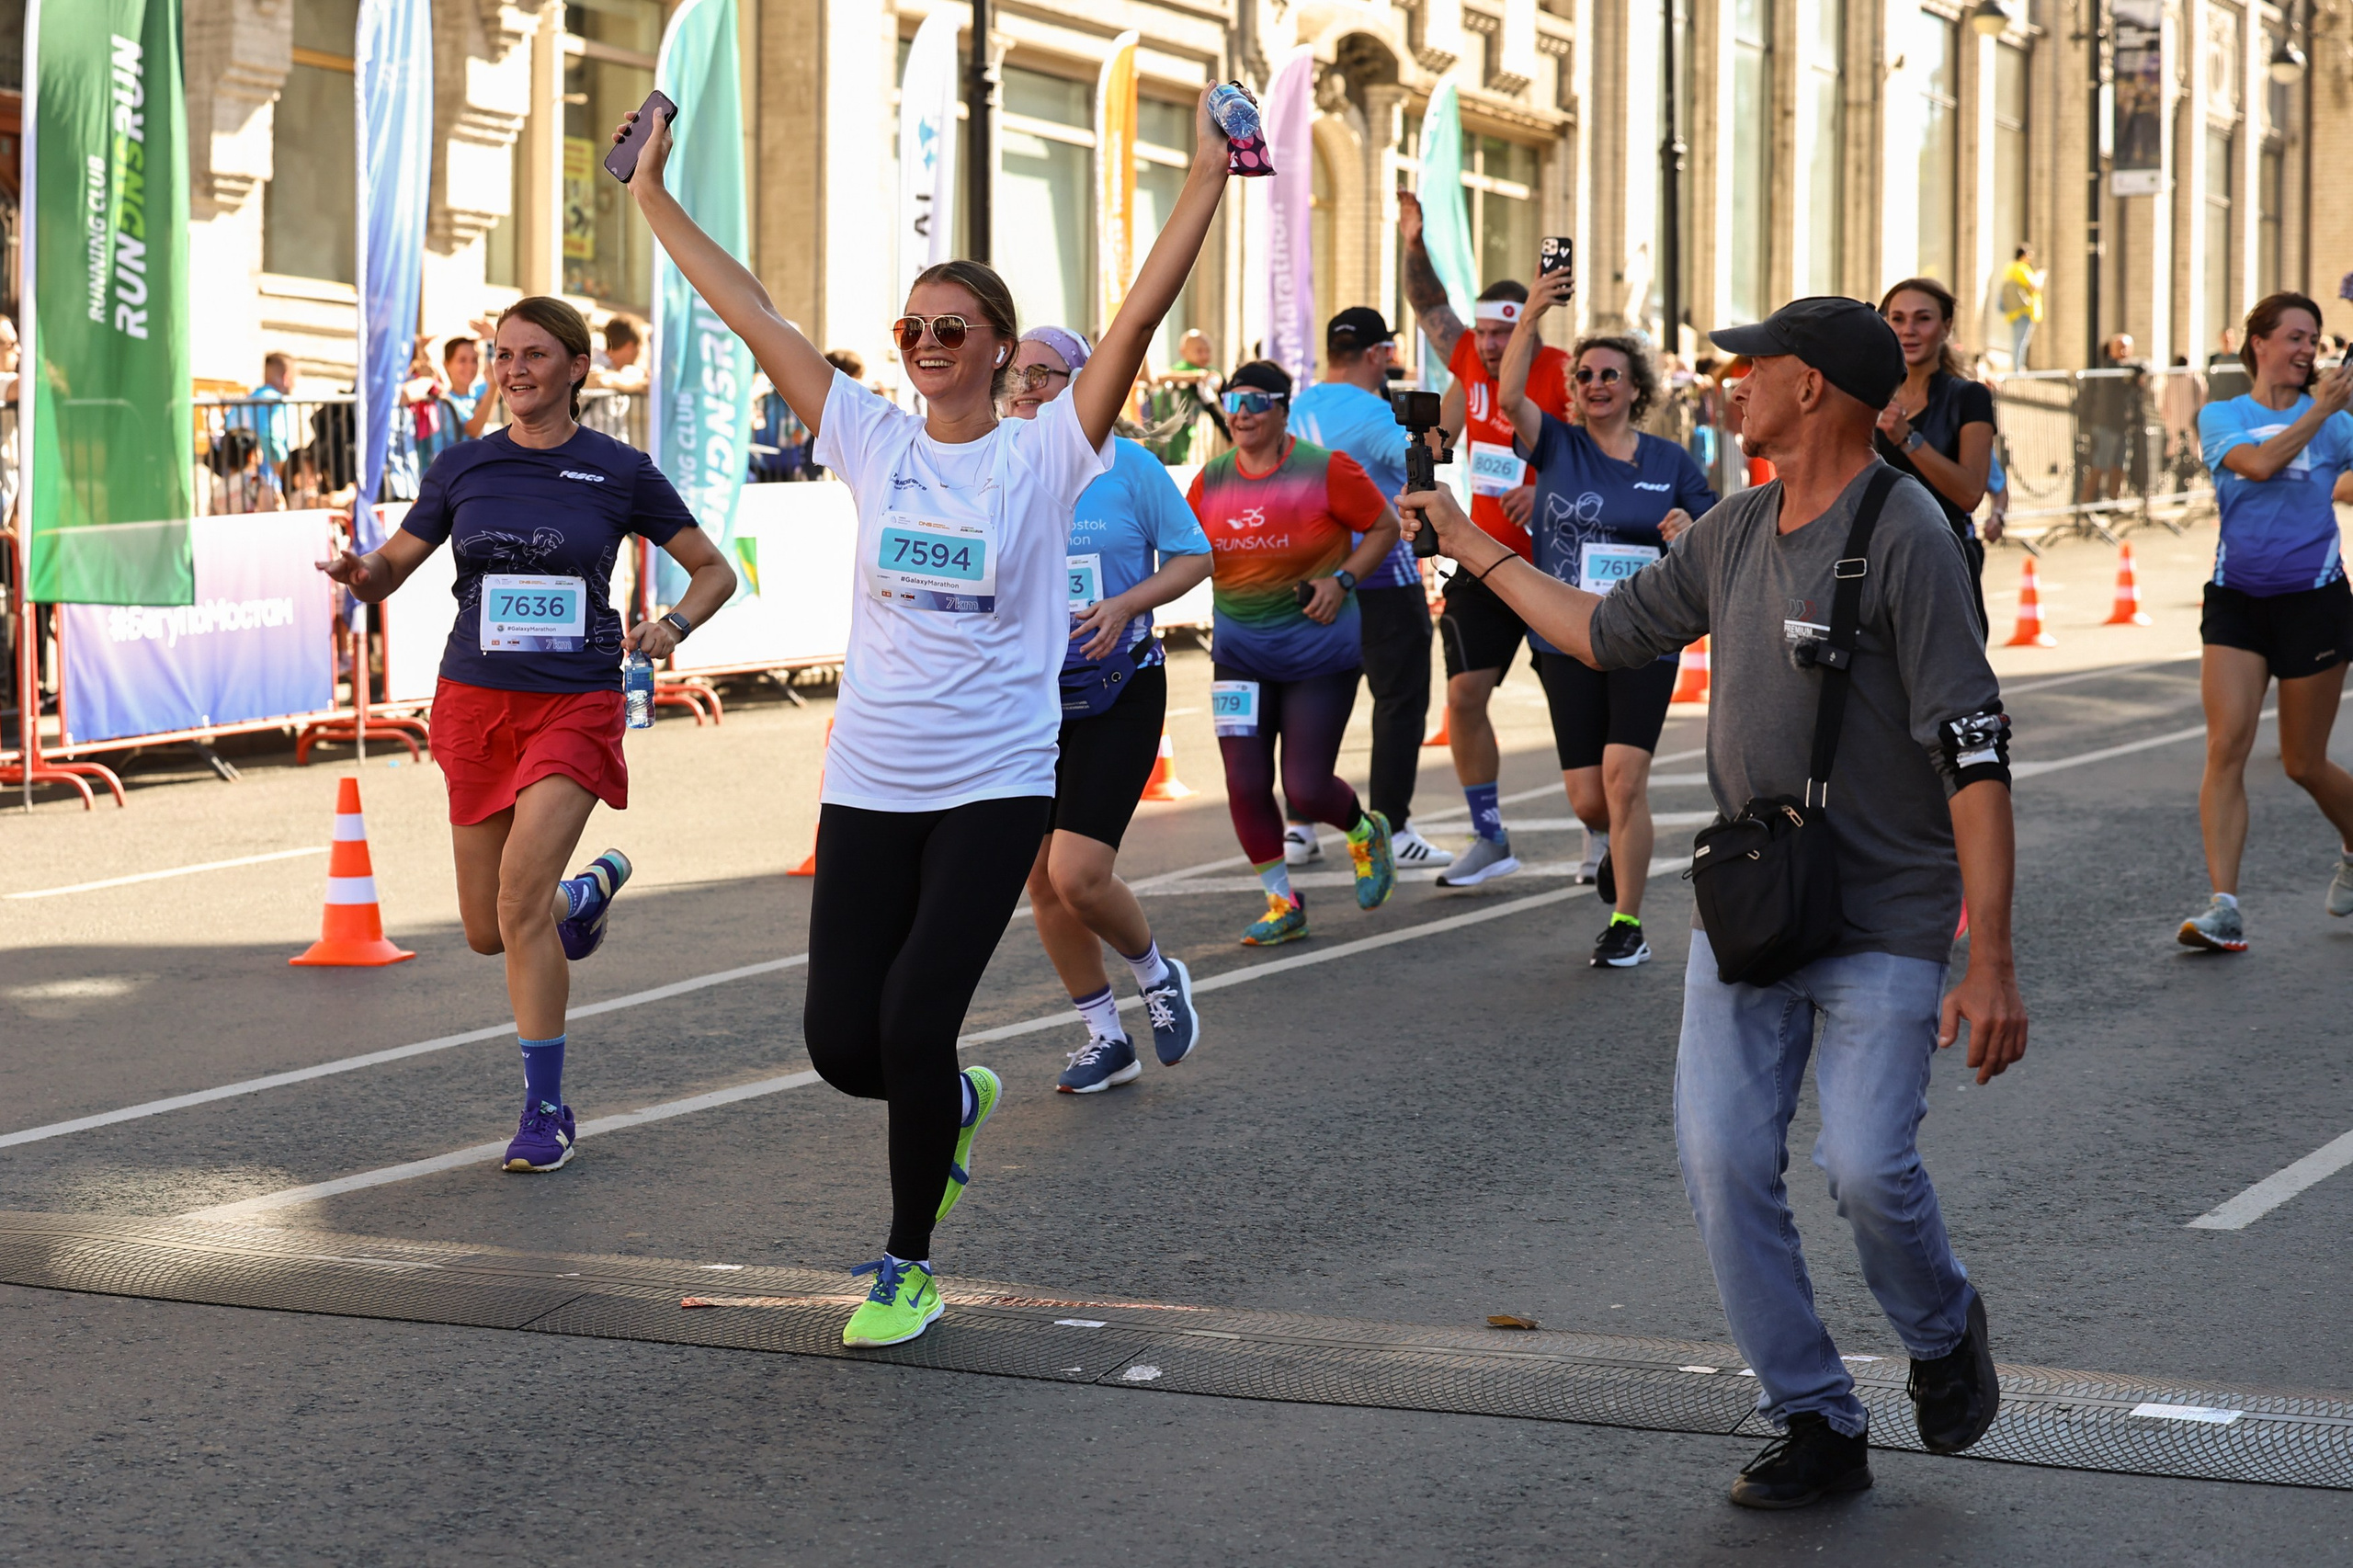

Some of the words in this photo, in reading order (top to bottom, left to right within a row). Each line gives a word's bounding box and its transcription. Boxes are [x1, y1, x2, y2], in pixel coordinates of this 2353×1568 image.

[87, 154, 107, 213] CLUB
[88, 214, 107, 324] RUNNING
[676, 392, 698, 452] CLUB
[1475, 457, 1512, 476] 8026
[559, 470, 605, 483] FESCO
[893, 537, 972, 572] 7594
[1600, 559, 1644, 576] 7617
[901, 575, 960, 589] #GalaxyMarathon
[1070, 574, 1085, 594] 3
[500, 596, 565, 618] 7636
[506, 626, 557, 637] #GalaxyMarathon
[1783, 624, 1813, 637] PREMIUM
[1212, 696, 1241, 711] 179
